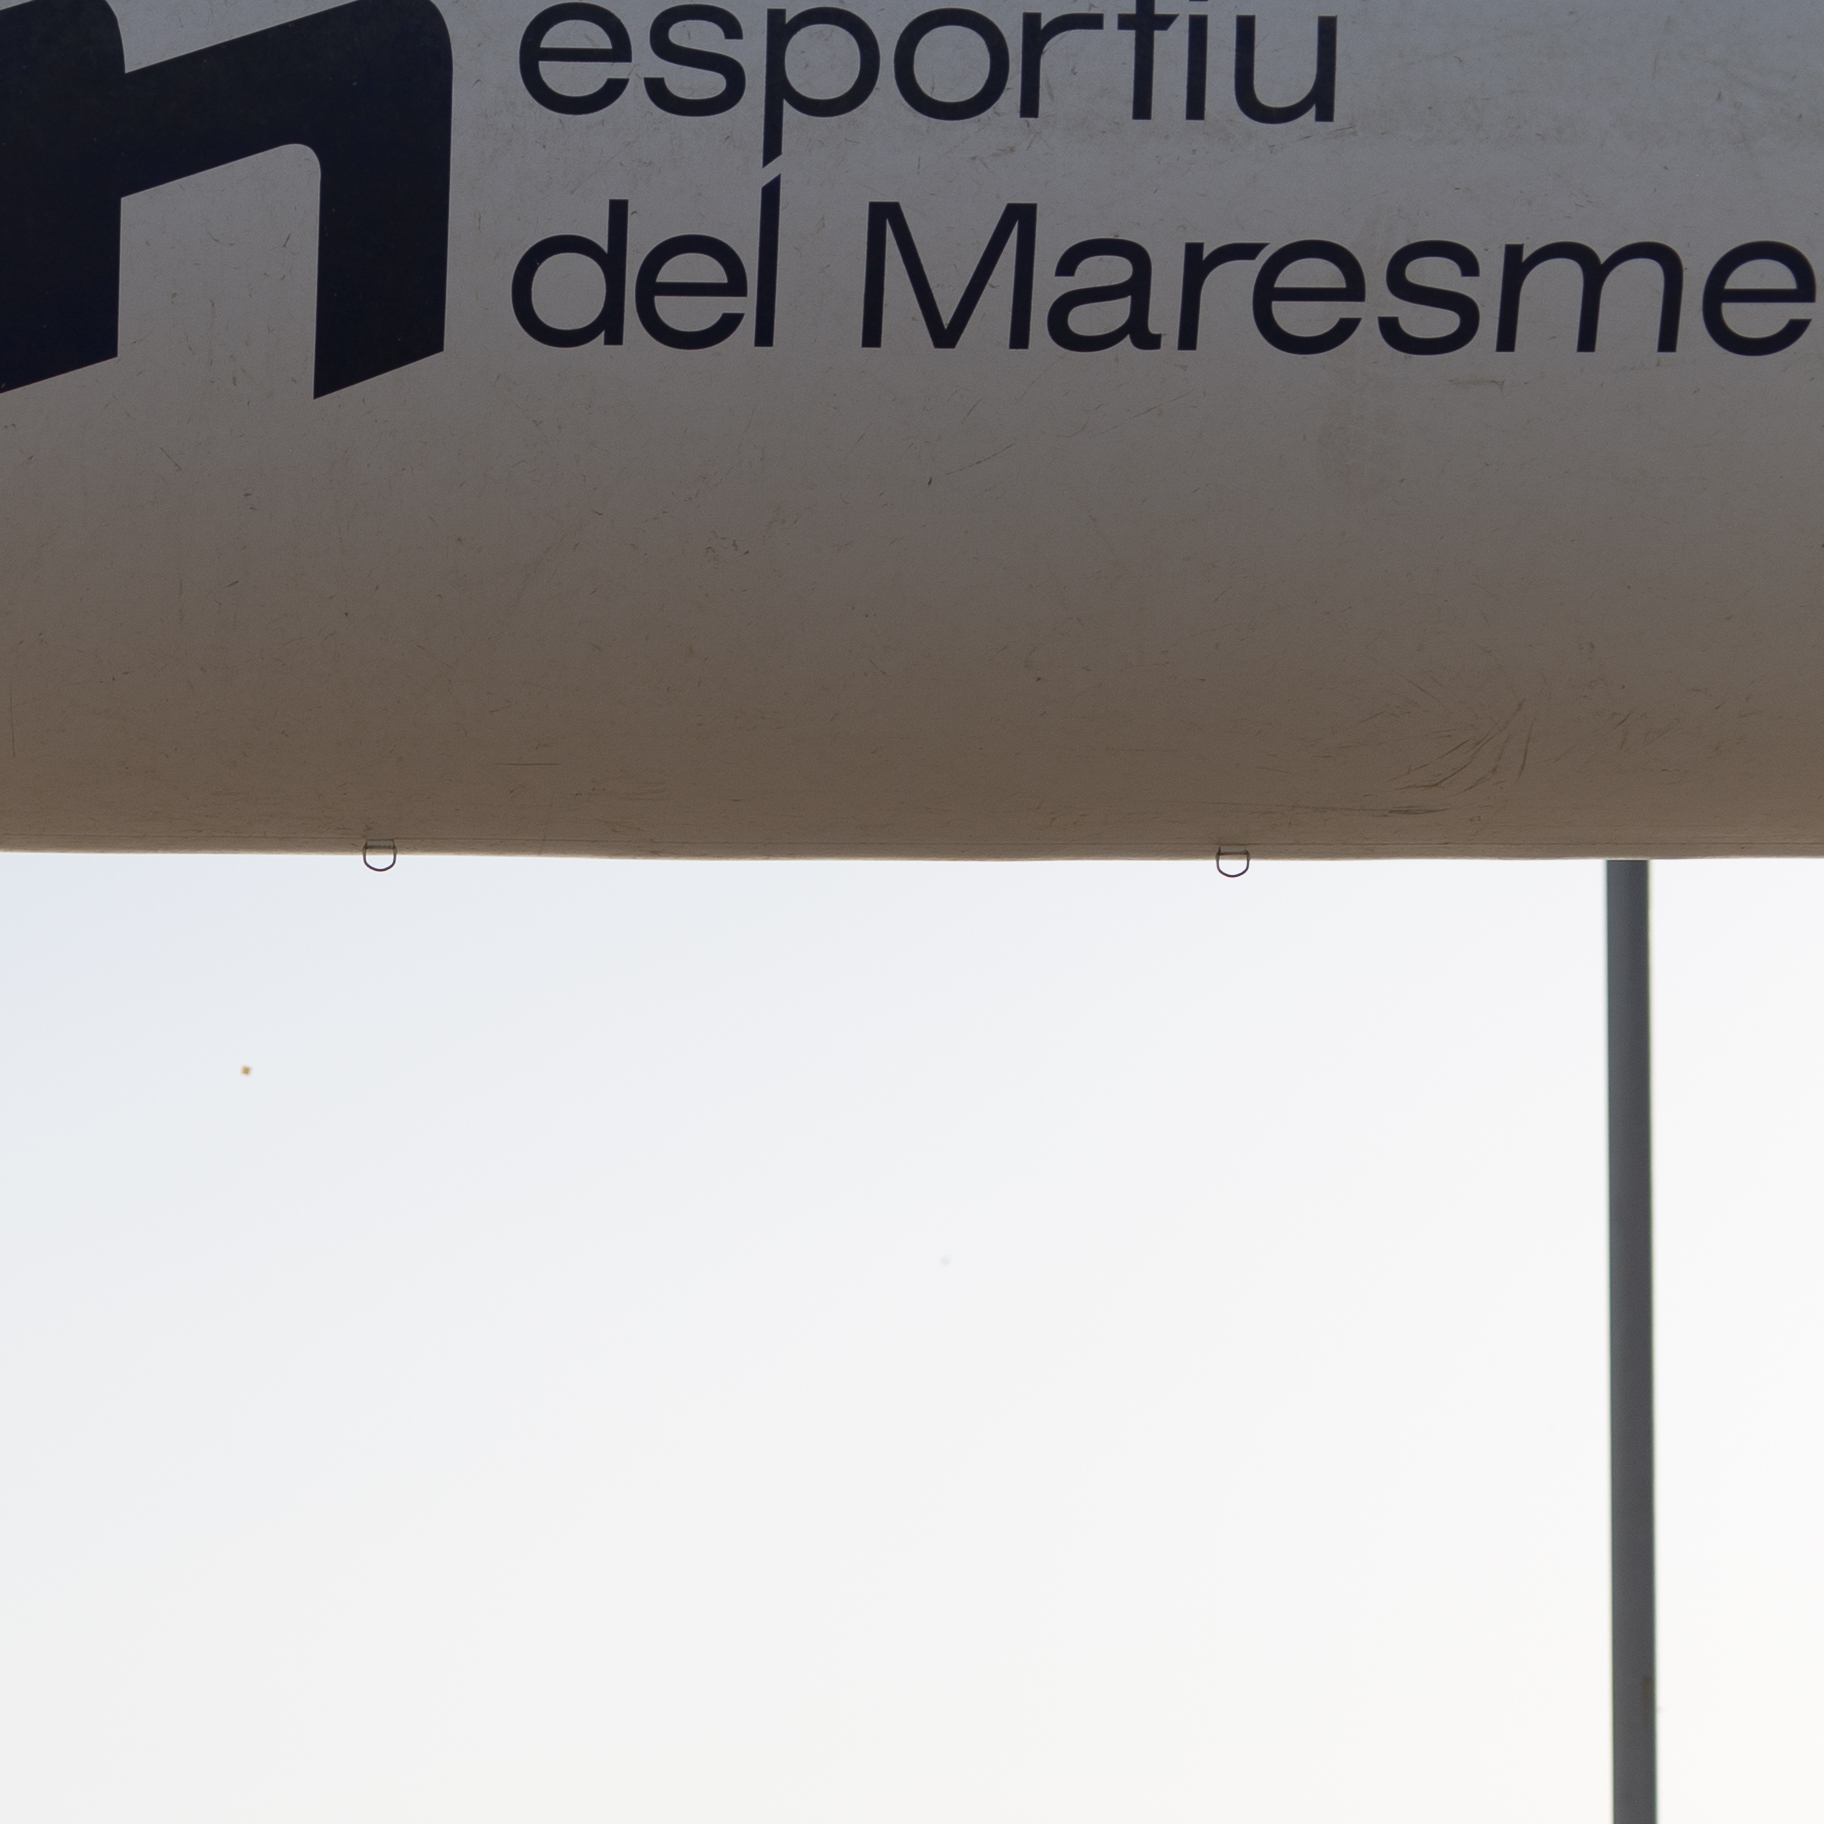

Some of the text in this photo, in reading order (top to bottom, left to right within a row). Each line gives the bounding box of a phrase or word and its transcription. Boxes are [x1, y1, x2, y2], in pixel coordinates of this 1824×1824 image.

[516, 0, 1340, 168] esportiu
[511, 174, 1818, 357] del Maresme
